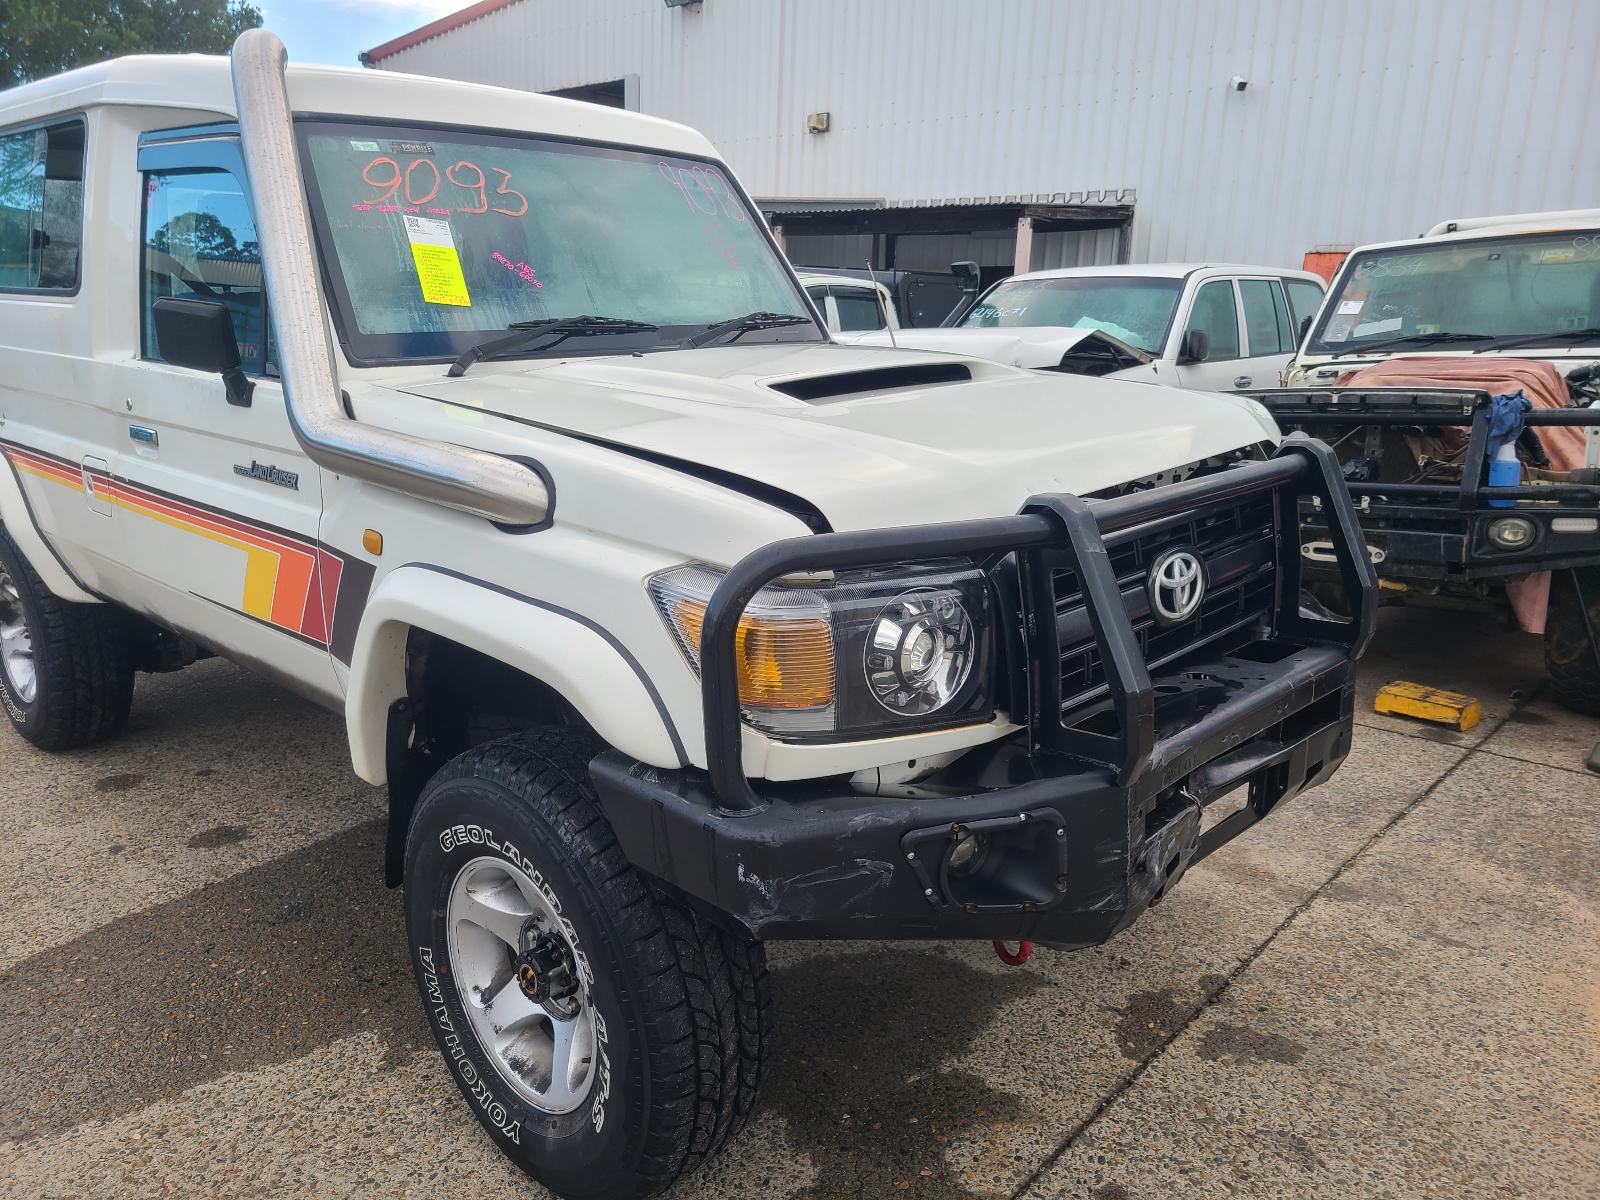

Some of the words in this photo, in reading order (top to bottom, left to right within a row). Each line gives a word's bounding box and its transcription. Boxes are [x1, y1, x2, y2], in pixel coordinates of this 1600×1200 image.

[362, 157, 529, 217] 9093
[658, 161, 745, 222] 9093
[439, 824, 595, 985] GEOLANDAR
[419, 946, 520, 1145] YOKOHAMA
